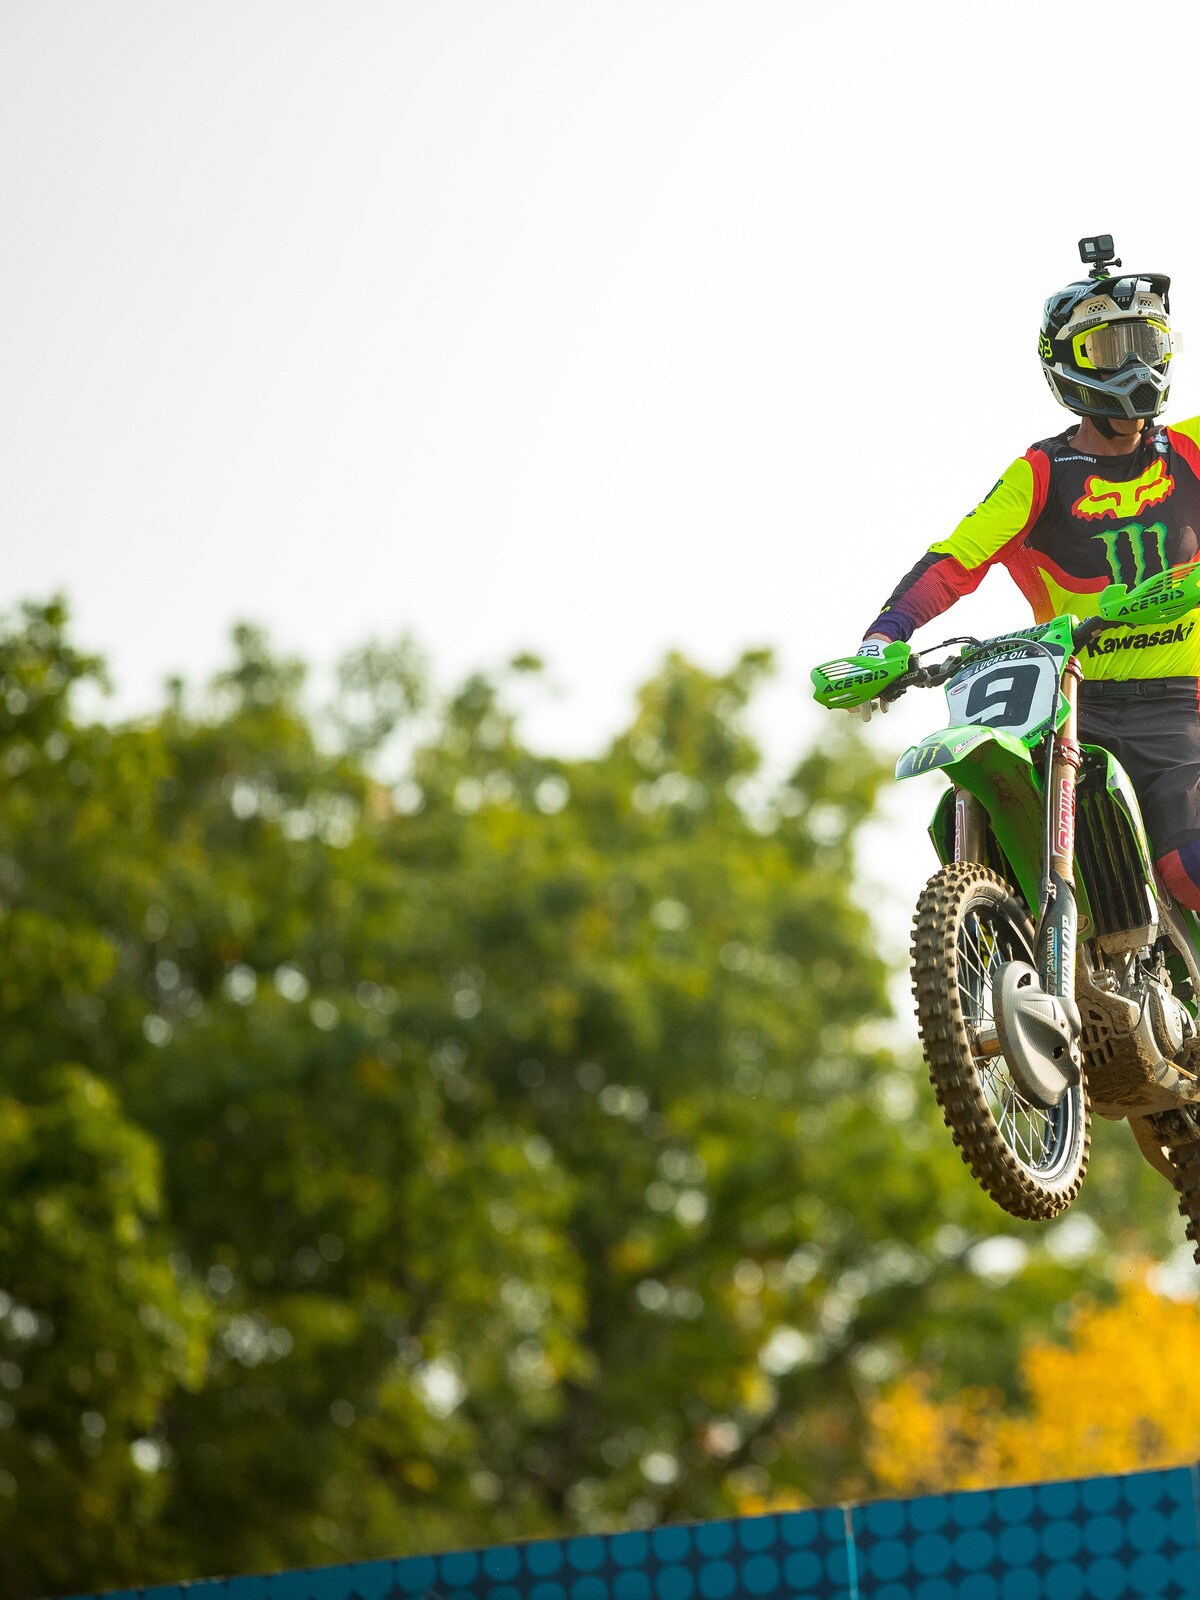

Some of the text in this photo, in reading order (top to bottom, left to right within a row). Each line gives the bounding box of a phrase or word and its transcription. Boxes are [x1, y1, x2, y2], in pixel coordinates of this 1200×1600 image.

[974, 650, 1028, 673] LUCAS OIL
[1086, 622, 1195, 659] Kawasaki
[965, 664, 1041, 728] 9
[1046, 926, 1055, 972] CARRILLO
[1061, 914, 1075, 999] DUNLOP
